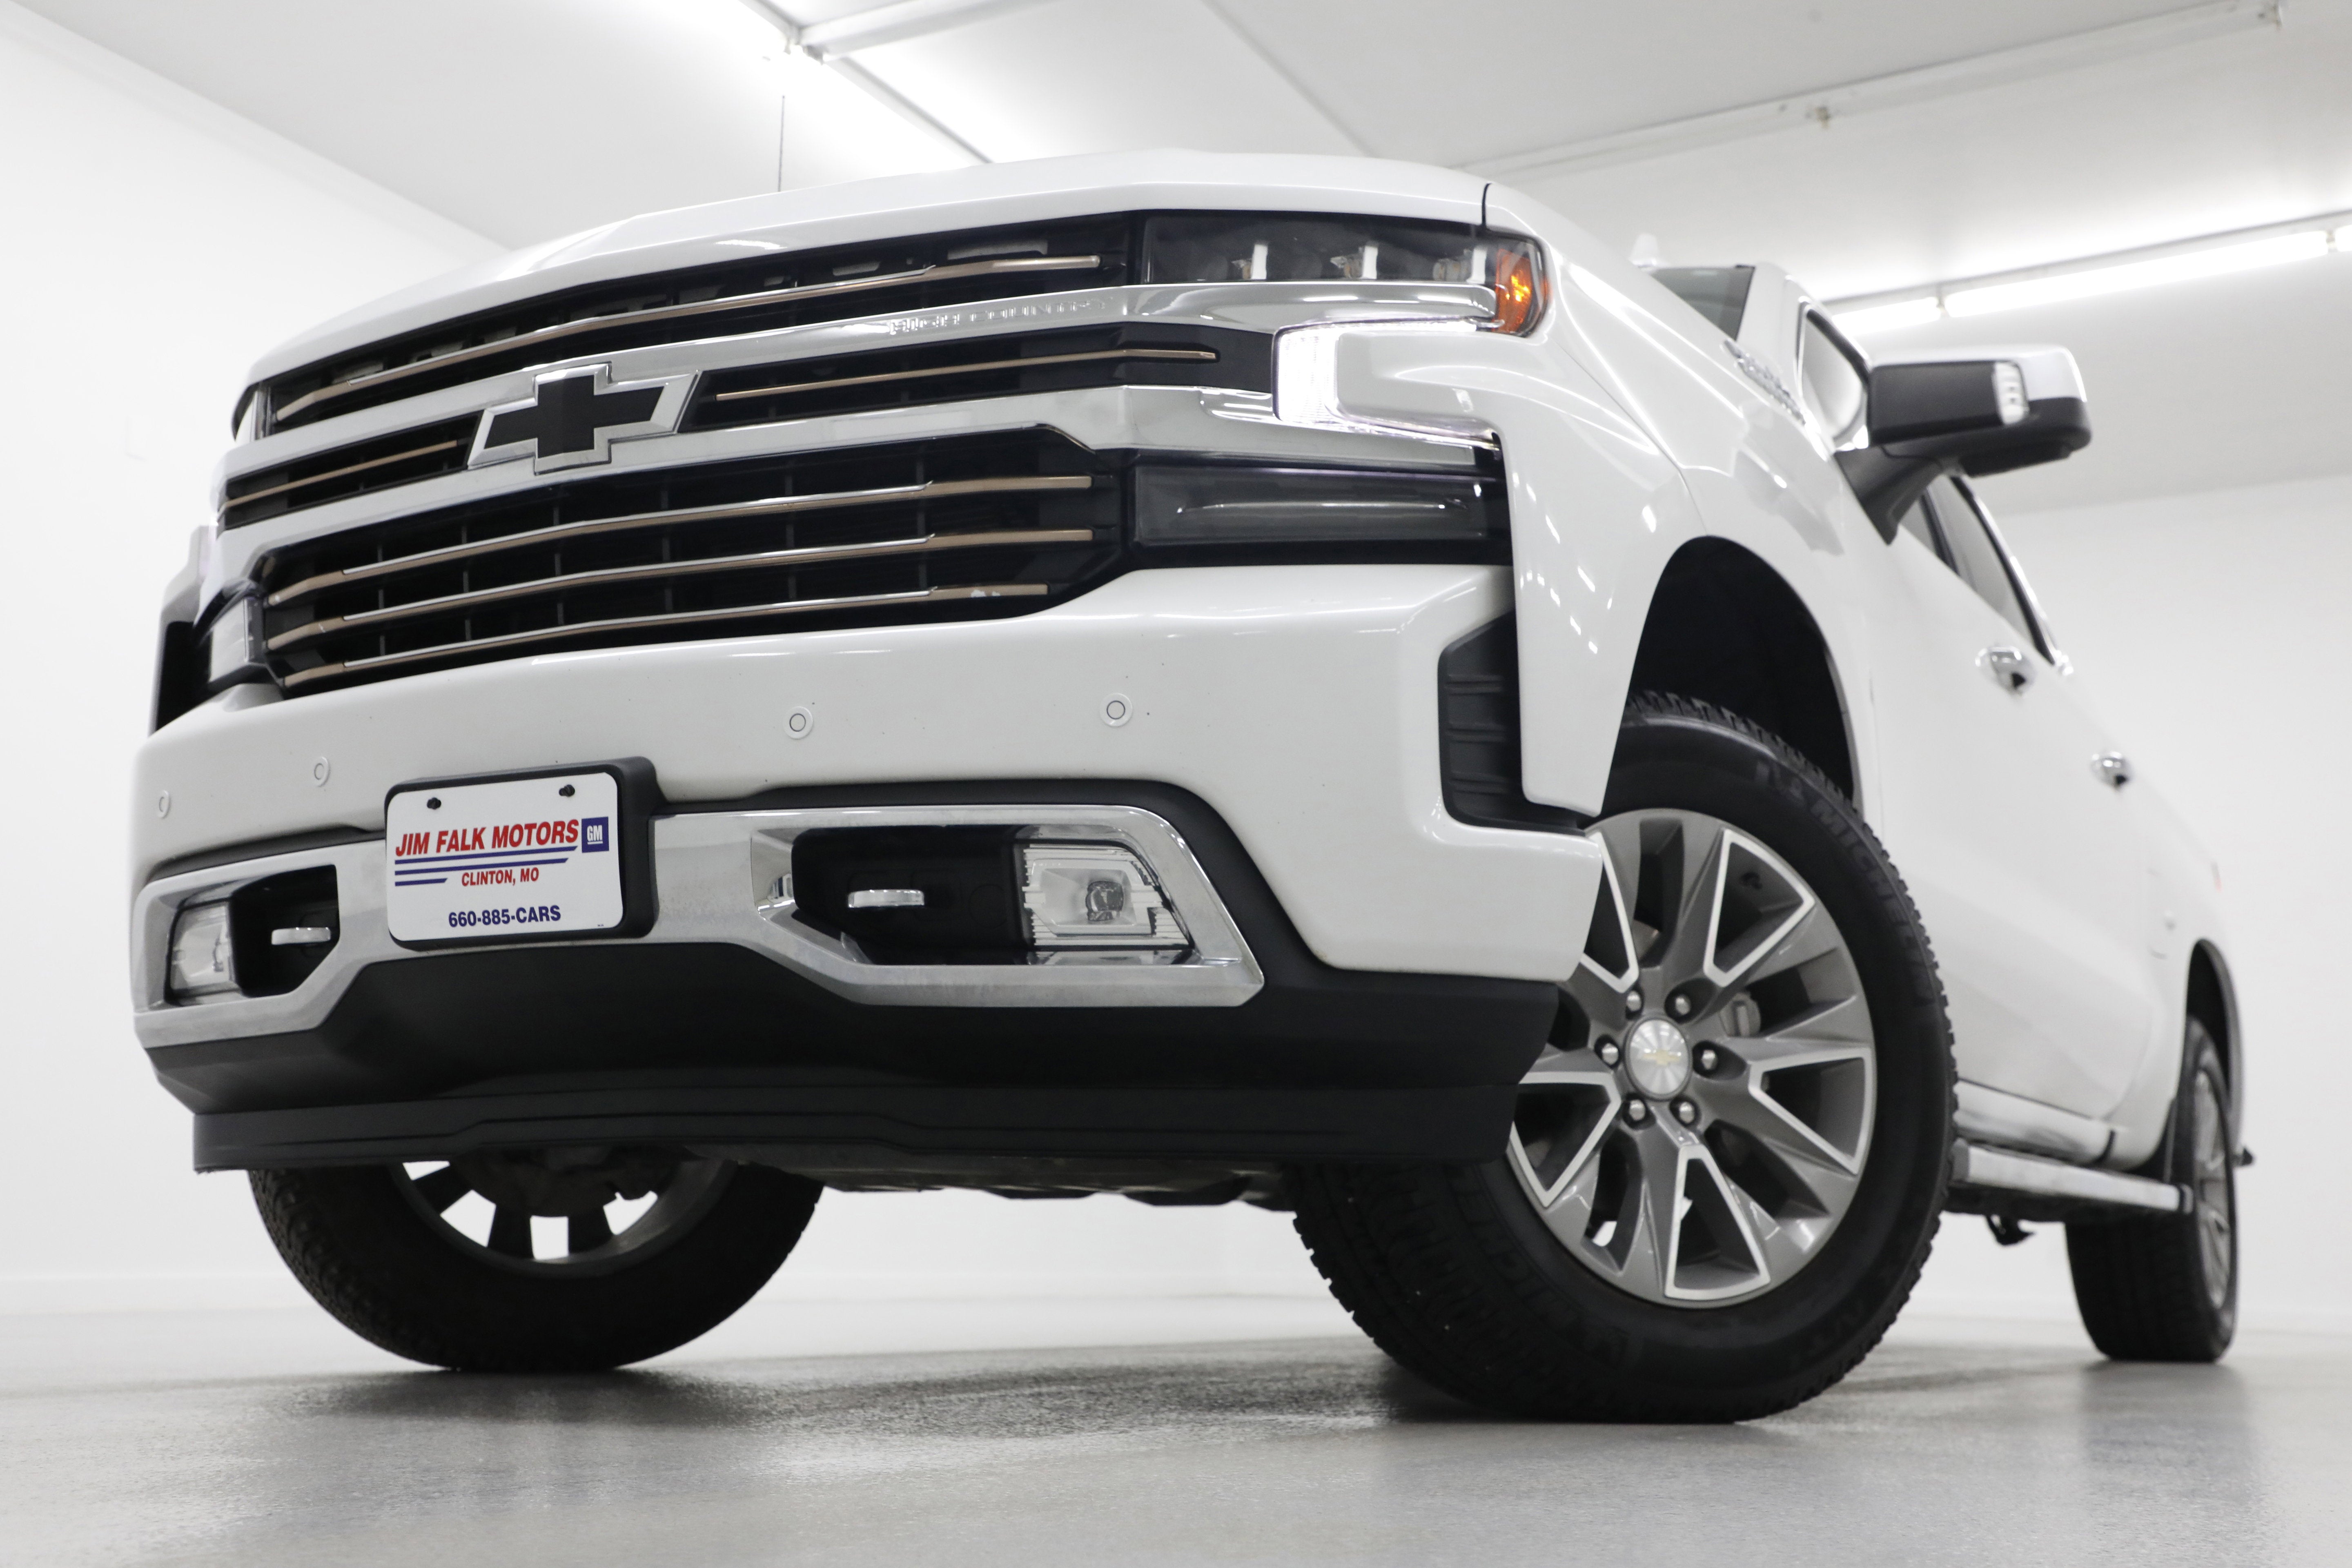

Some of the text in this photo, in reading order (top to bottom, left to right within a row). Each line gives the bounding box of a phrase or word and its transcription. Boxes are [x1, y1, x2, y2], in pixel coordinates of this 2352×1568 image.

[395, 819, 579, 856] JIM FALK MOTORS
[586, 825, 603, 842] GM
[461, 867, 539, 886] CLINTON, MO
[448, 905, 561, 927] 660-885-CARS
